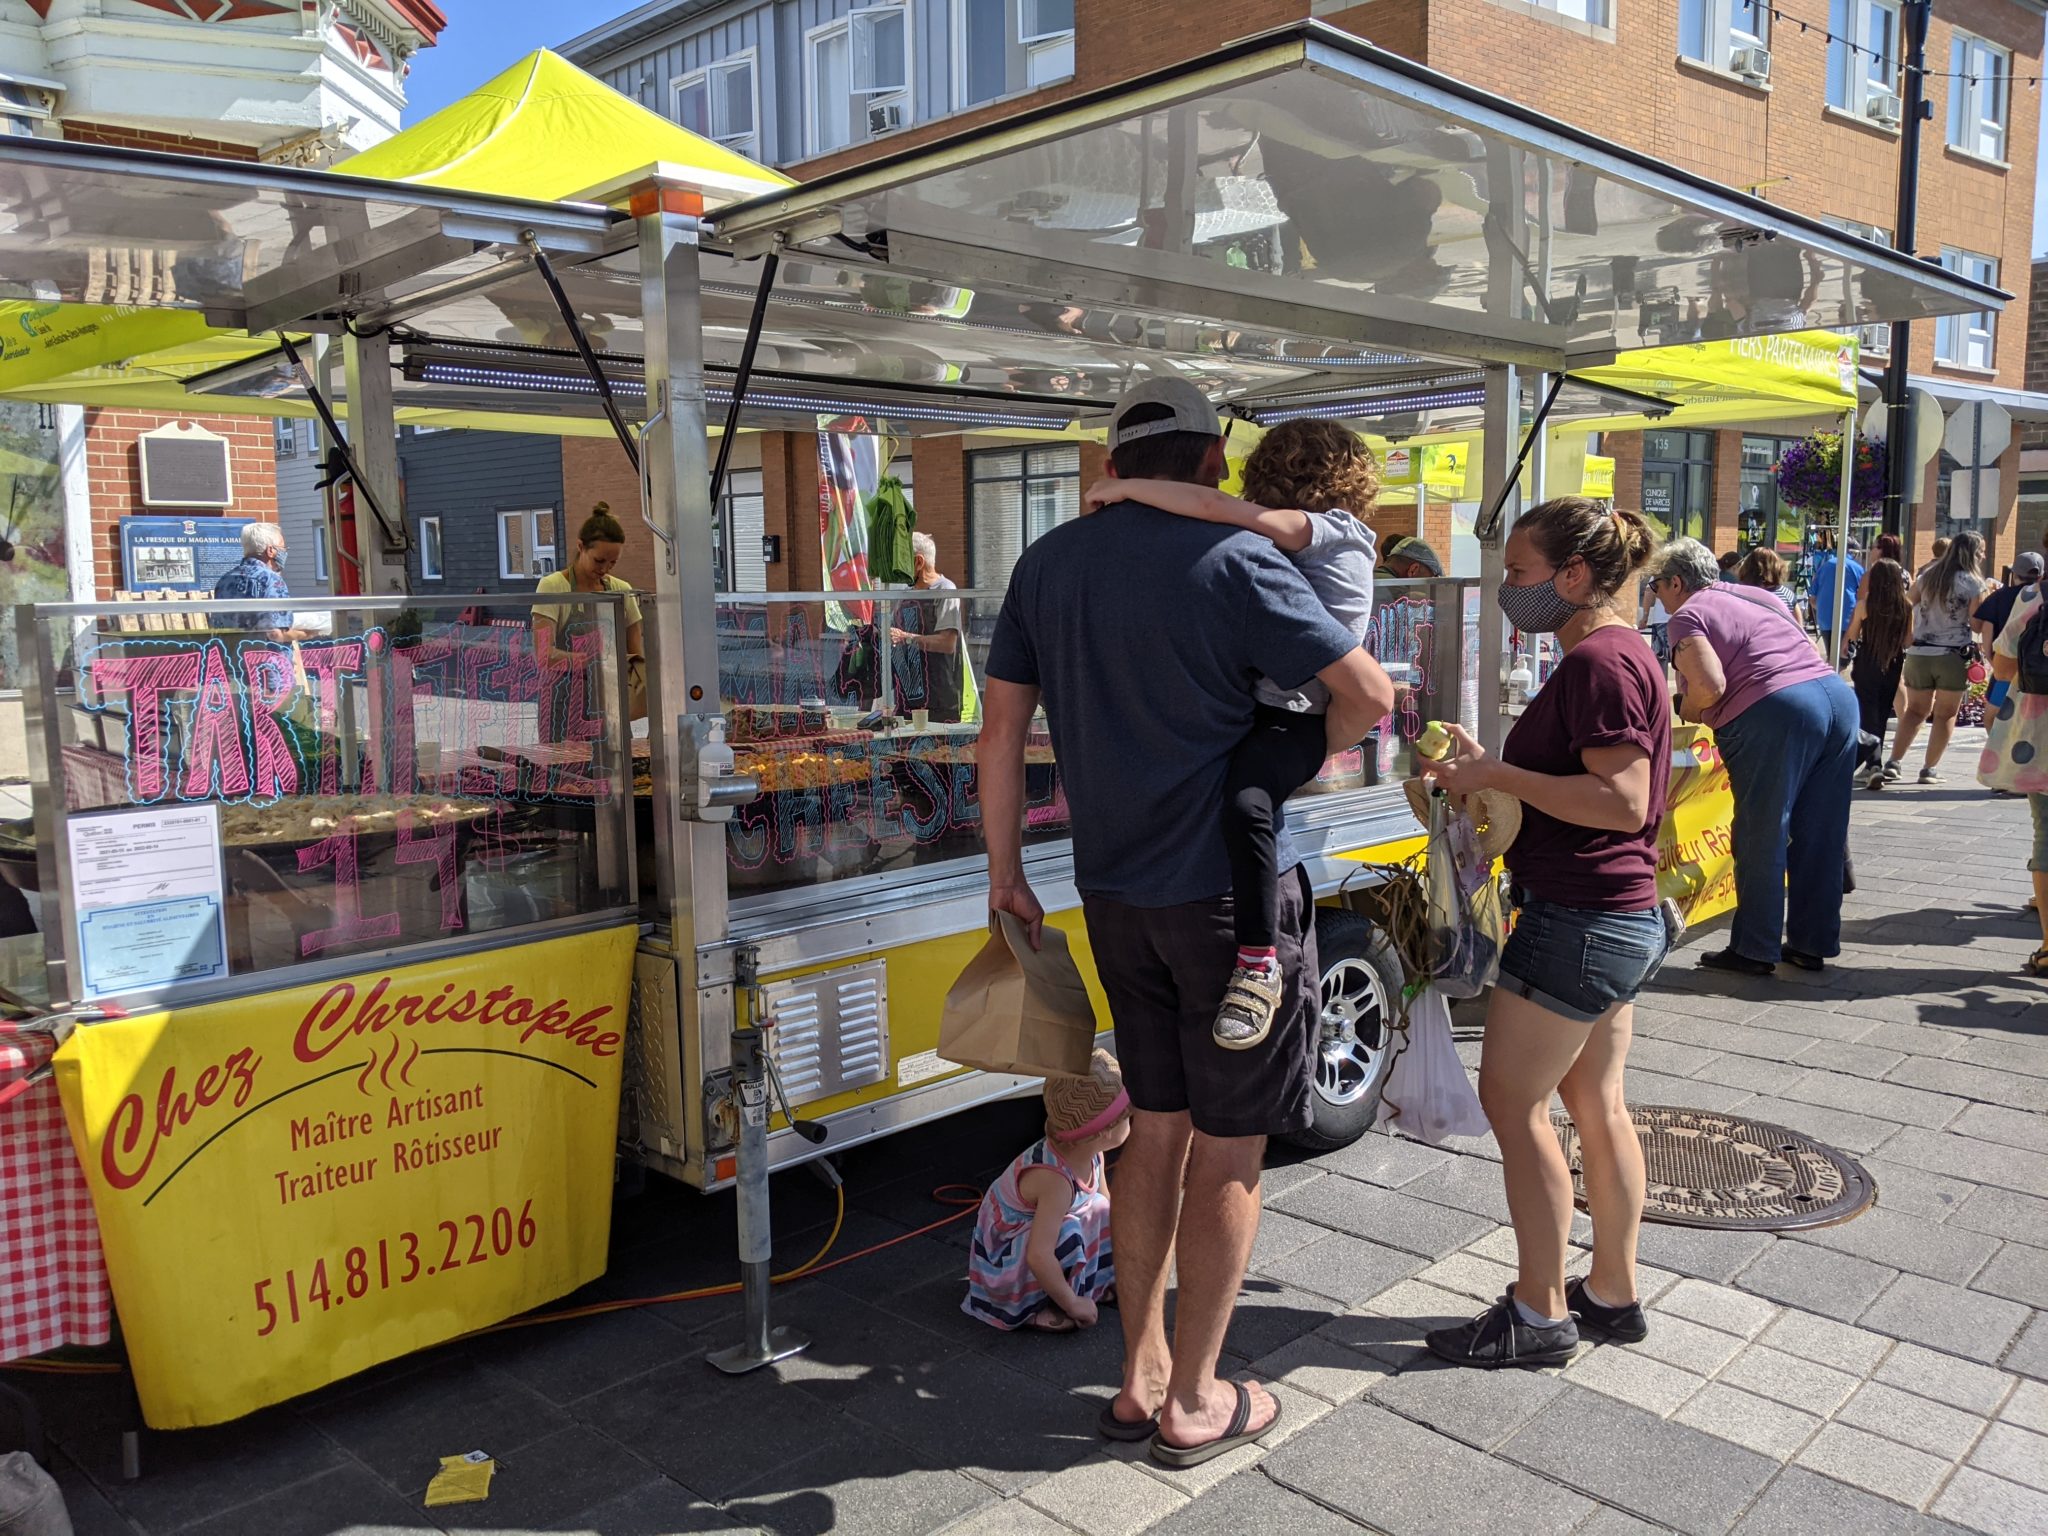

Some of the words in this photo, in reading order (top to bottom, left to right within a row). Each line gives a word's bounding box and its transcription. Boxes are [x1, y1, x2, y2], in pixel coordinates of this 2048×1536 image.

[1730, 335, 1762, 361] FIERS
[1765, 334, 1839, 378] PARTENAIRES
[1655, 438, 1669, 451] 135
[1658, 838, 1706, 875] aiteur
[101, 1046, 262, 1190] Chez
[293, 976, 622, 1064] Christophe
[290, 1110, 372, 1151] Maître
[387, 1083, 484, 1129] Artisant
[275, 1155, 377, 1204] Traiteur
[394, 1125, 502, 1174] Rôtisseur
[255, 1199, 537, 1337] 514.813.2206
